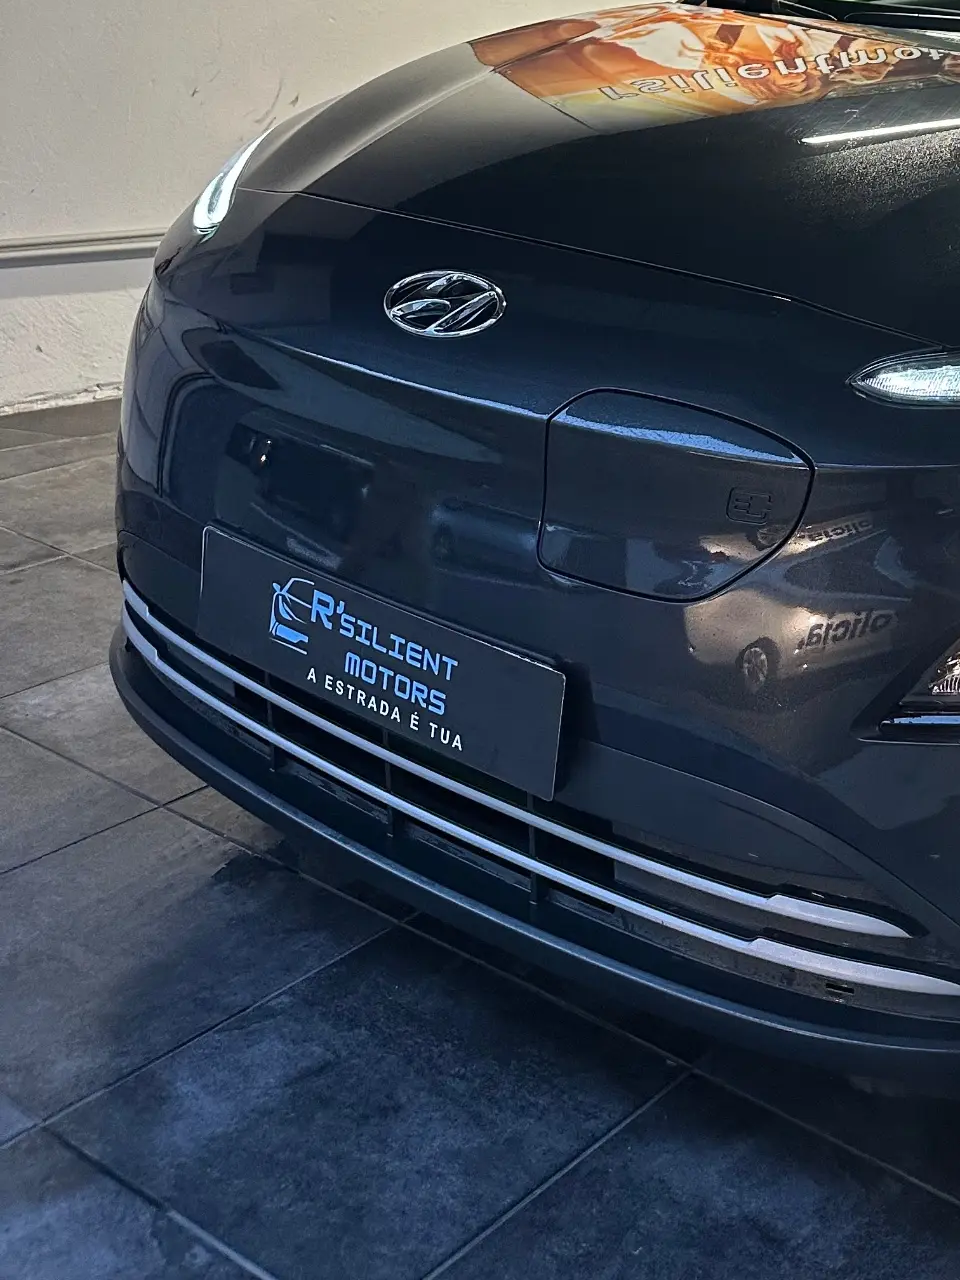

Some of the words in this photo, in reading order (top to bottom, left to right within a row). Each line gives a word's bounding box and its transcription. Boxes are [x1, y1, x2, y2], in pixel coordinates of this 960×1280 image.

[307, 667, 317, 684] A
[324, 675, 401, 723] ESTRADA
[409, 711, 420, 730] É
[429, 721, 463, 751] TUA
[344, 651, 446, 716] MOTORS
